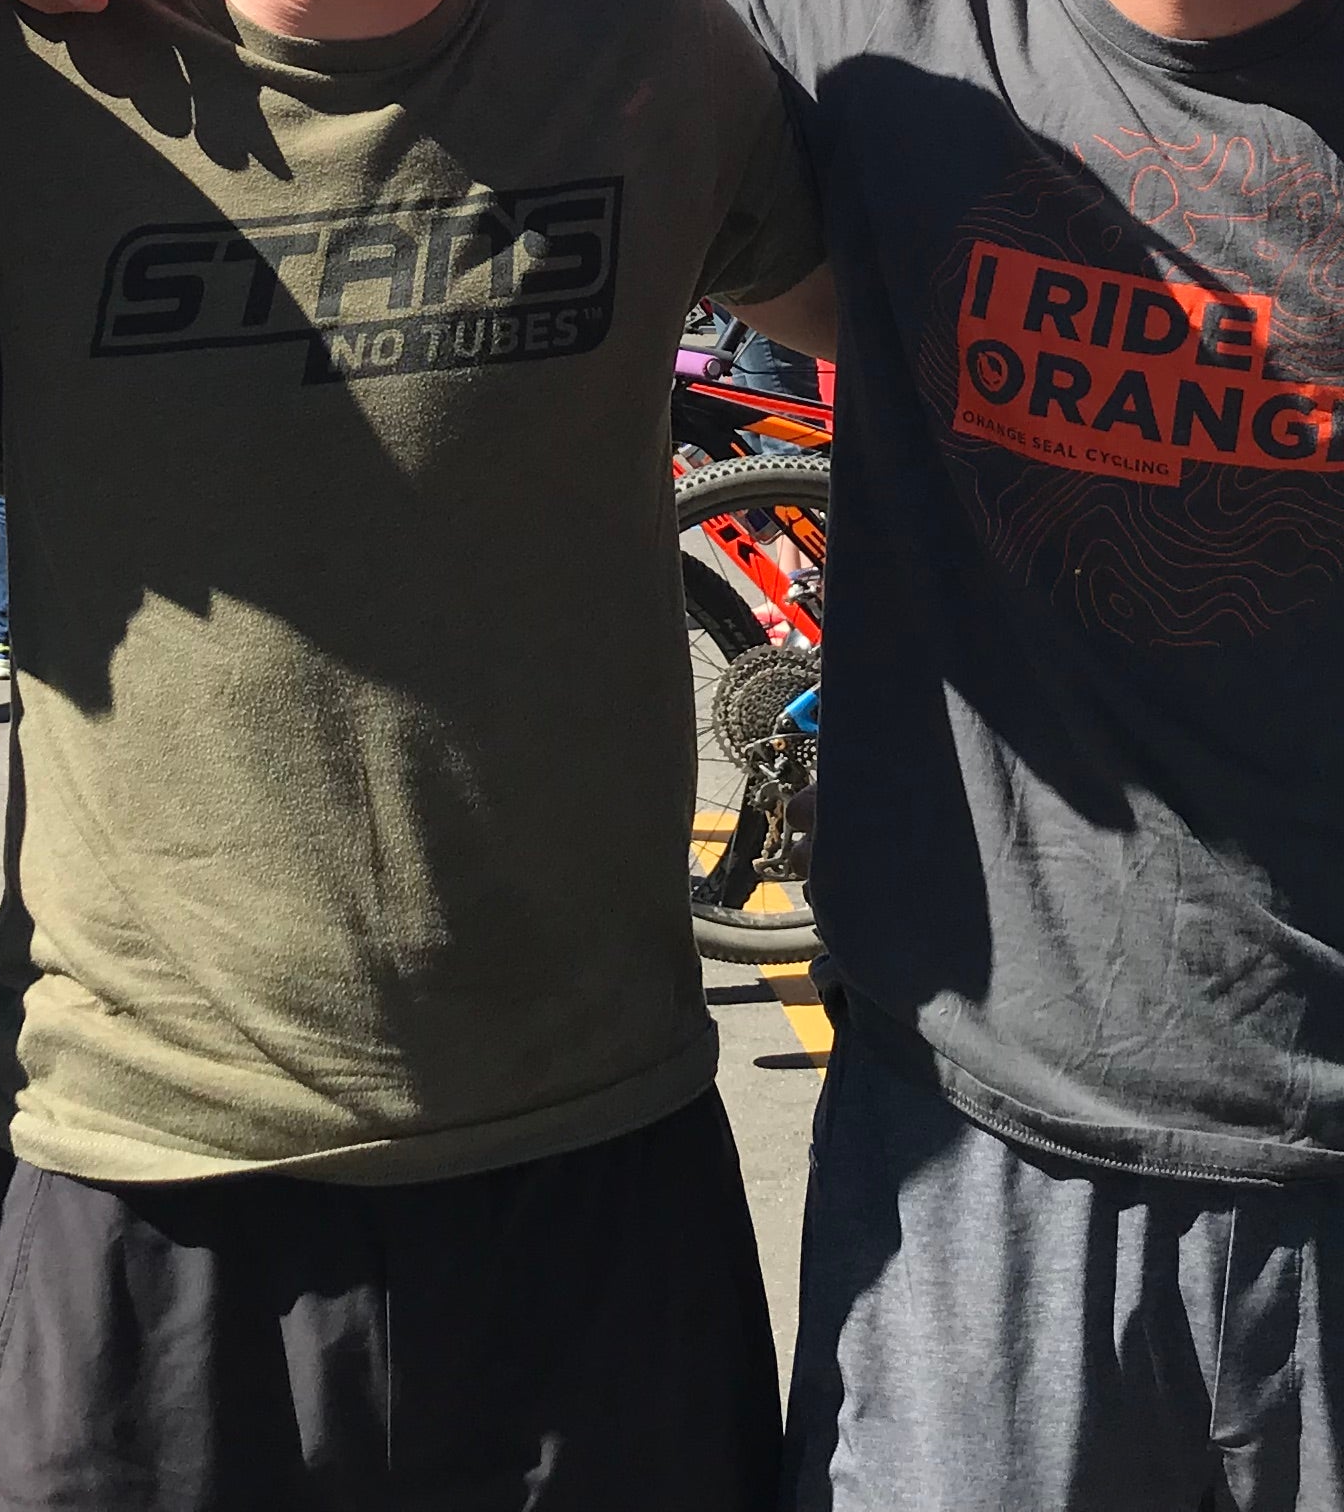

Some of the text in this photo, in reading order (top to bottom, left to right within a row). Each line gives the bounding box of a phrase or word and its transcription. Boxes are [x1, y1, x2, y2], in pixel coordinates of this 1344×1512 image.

[969, 255, 1258, 371] I RIDE
[329, 327, 404, 370] NO
[962, 409, 1170, 476] ORANGE SEAL CYCLING
